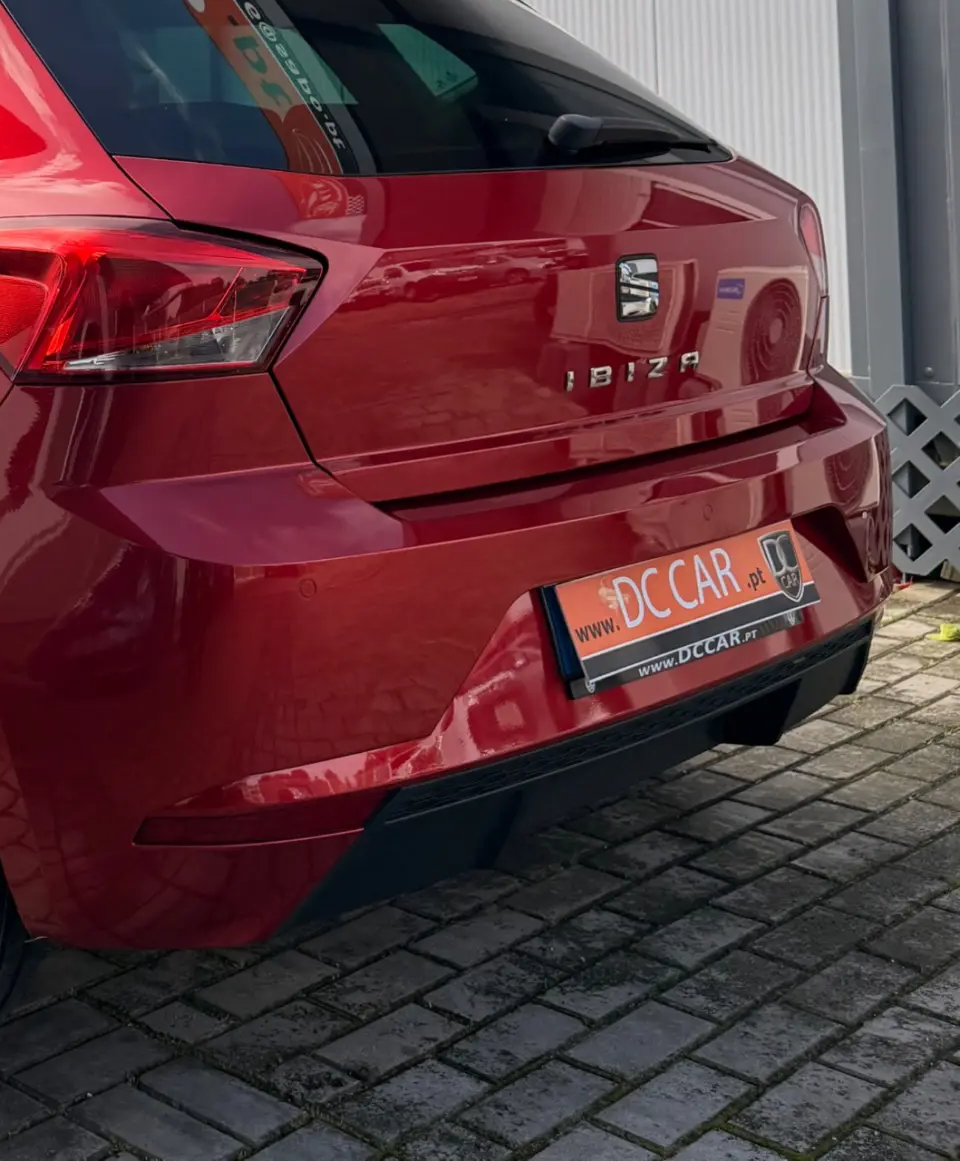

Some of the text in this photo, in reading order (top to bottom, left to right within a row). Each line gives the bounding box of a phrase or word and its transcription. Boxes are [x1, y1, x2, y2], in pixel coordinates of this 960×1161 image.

[565, 351, 700, 392] IBIZA
[780, 572, 798, 589] CAR
[638, 629, 759, 678] www.DCCAR.PT
